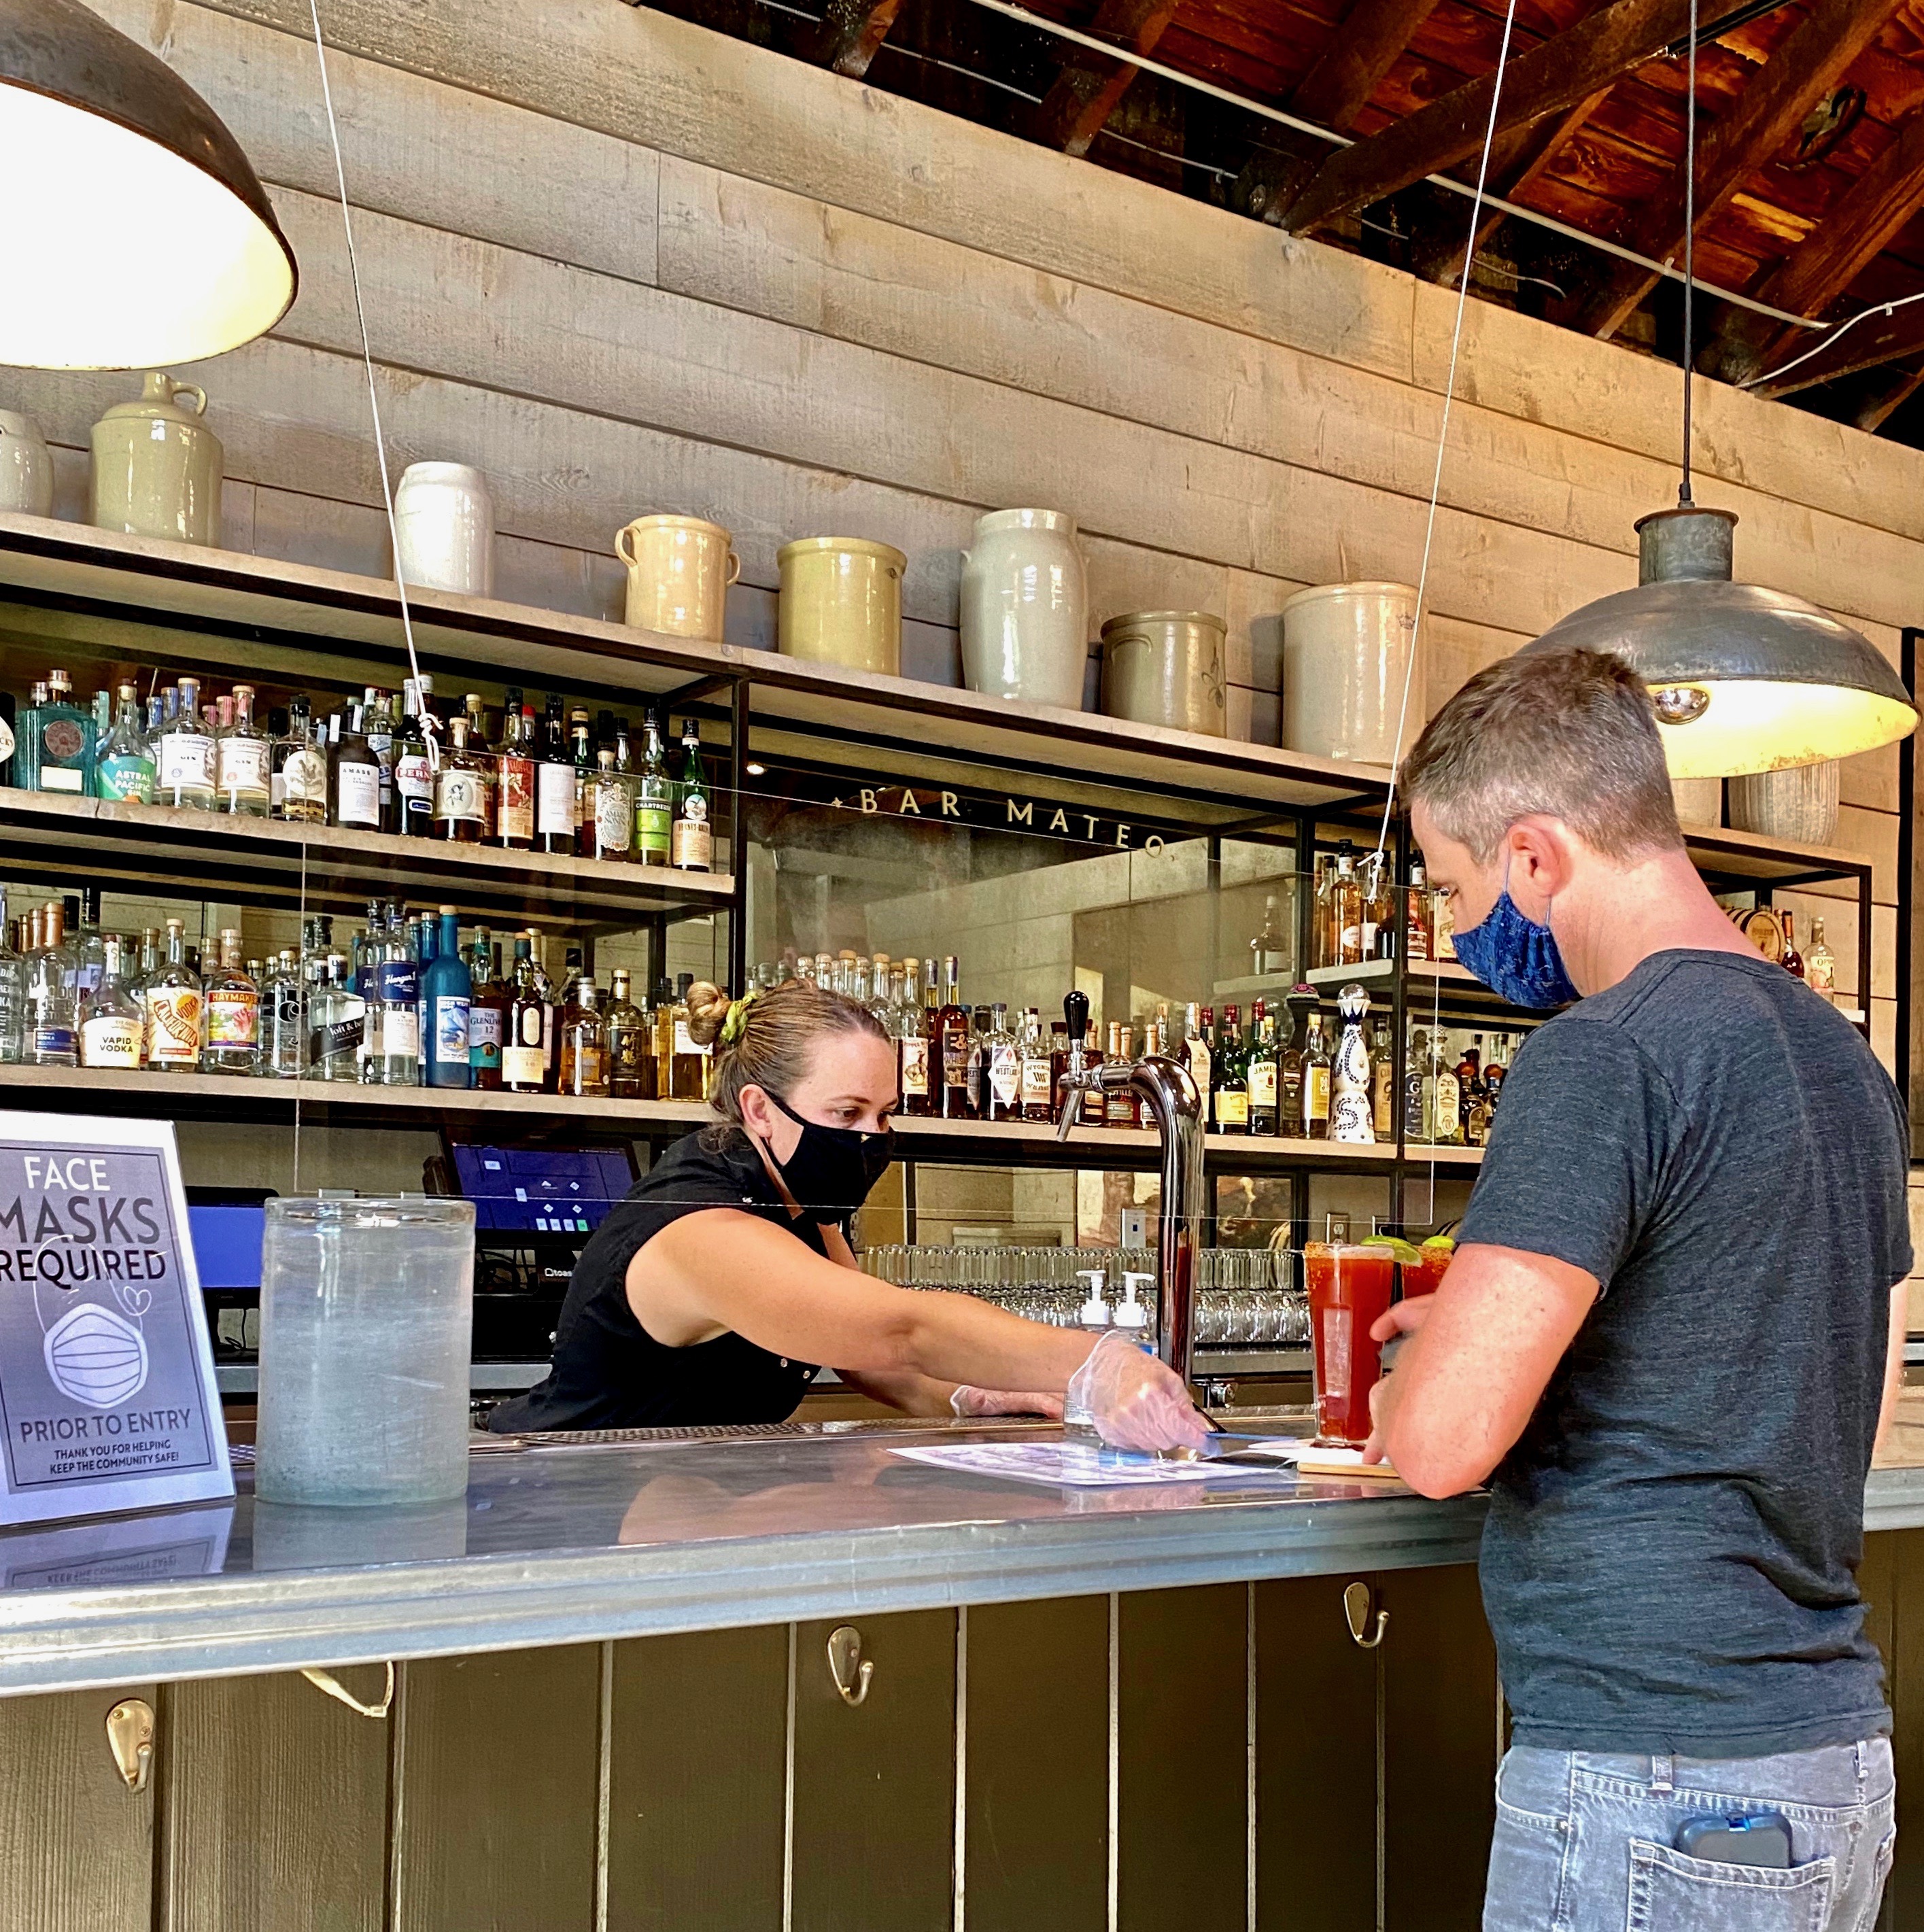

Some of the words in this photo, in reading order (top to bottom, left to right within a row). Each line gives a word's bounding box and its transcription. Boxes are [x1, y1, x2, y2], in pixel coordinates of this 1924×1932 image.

[115, 770, 151, 782] ASTRAL
[115, 780, 150, 792] PACIFIC
[859, 789, 961, 816] BAR
[1007, 799, 1165, 858] MATEO
[176, 997, 199, 1019] VODKA
[154, 1000, 197, 1046] CALIFORNIA
[100, 1044, 133, 1053] VODKA
[103, 1037, 131, 1045] VAPID
[24, 1156, 111, 1191] FACE
[0, 1195, 160, 1245] MASKS
[0, 1249, 166, 1290] REQUIRED
[20, 1417, 88, 1443] PRIOR
[91, 1415, 122, 1436] TO
[128, 1409, 191, 1434] ENTRY
[54, 1447, 88, 1460] THANK
[90, 1445, 110, 1456] YOU
[112, 1443, 131, 1454] FOR
[133, 1439, 171, 1451] HELPING
[50, 1462, 75, 1474] KEEP
[77, 1460, 95, 1471] THE
[97, 1454, 153, 1469] COMMUNITY
[155, 1451, 179, 1463] SAFE!
